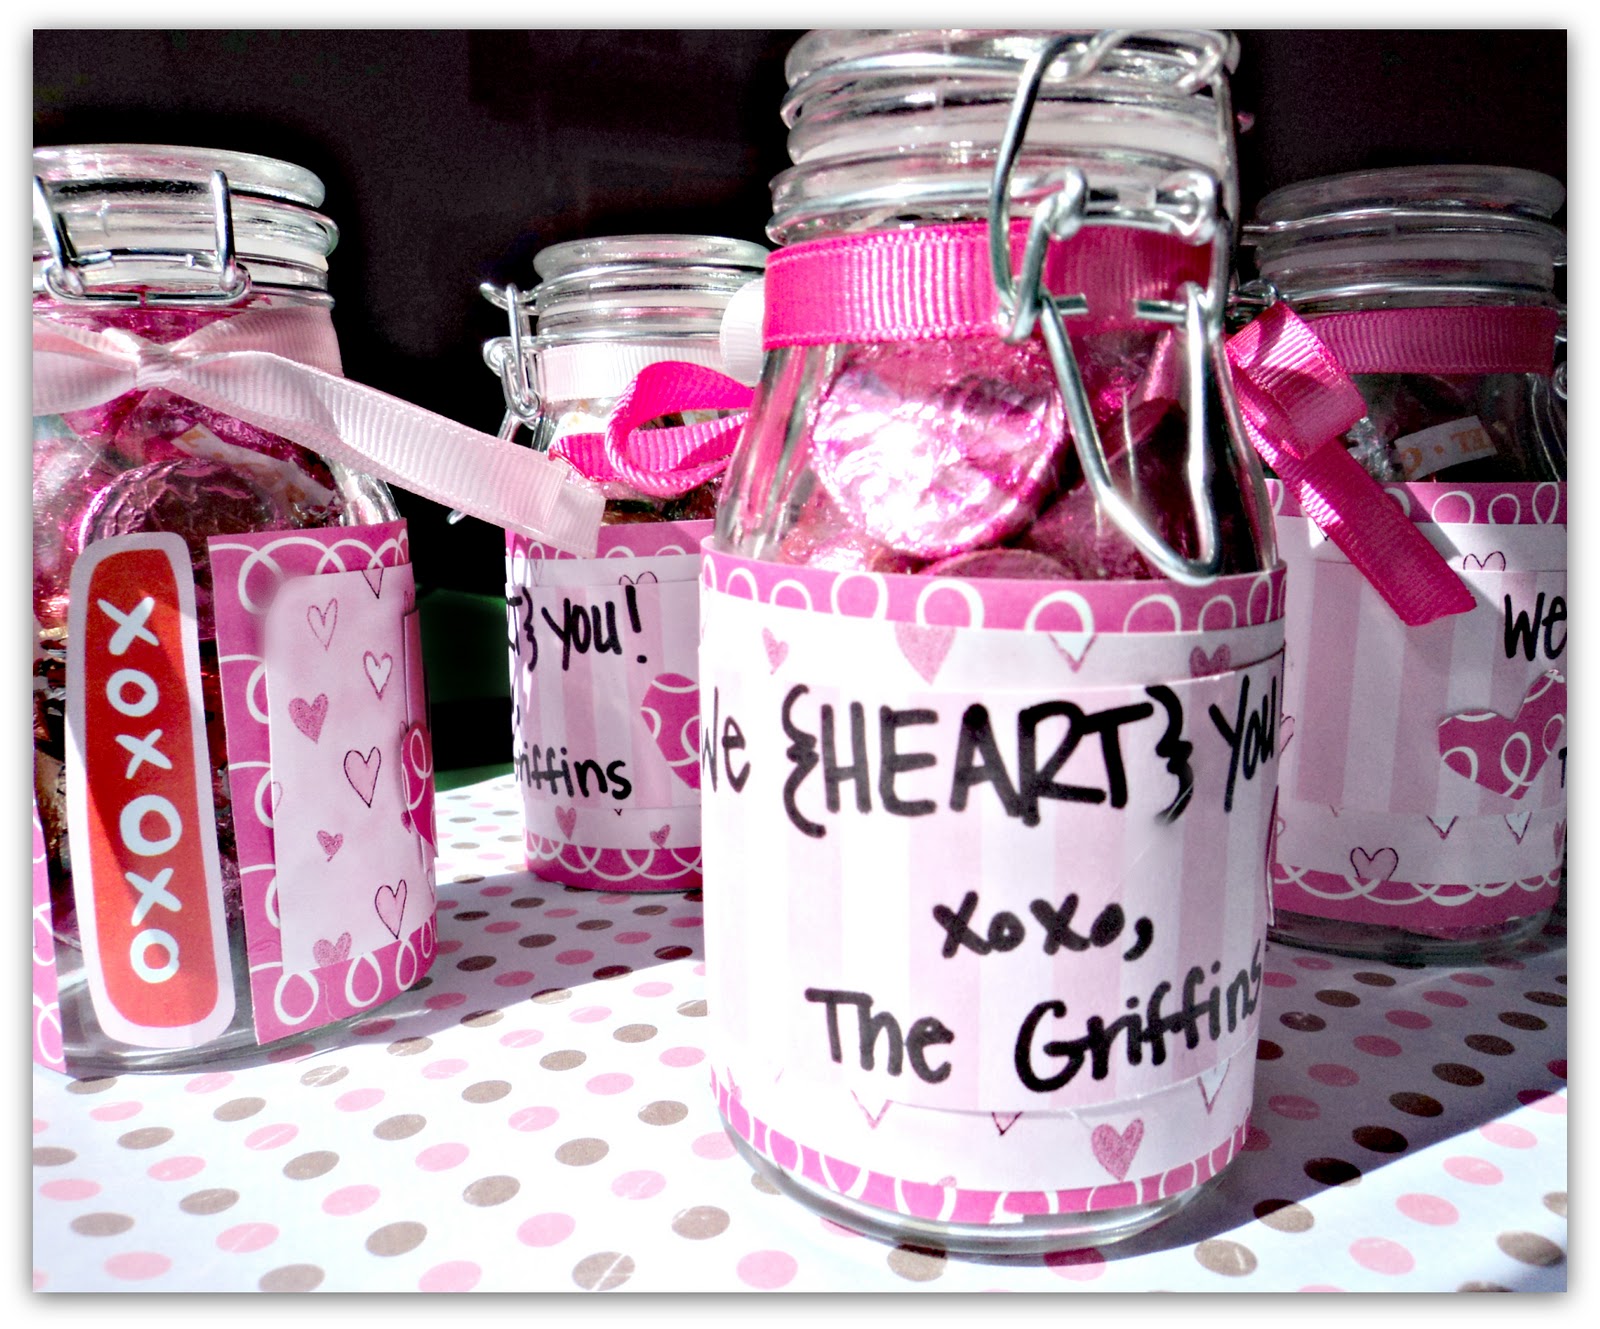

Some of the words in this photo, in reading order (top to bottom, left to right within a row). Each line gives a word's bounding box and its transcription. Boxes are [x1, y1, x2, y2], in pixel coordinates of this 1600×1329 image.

[1503, 591, 1568, 662] We
[513, 742, 633, 801] riffins
[700, 685, 752, 794] We
[781, 684, 1194, 839] {HEART}
[804, 987, 955, 1084] The
[1014, 938, 1262, 1093] Griffins
